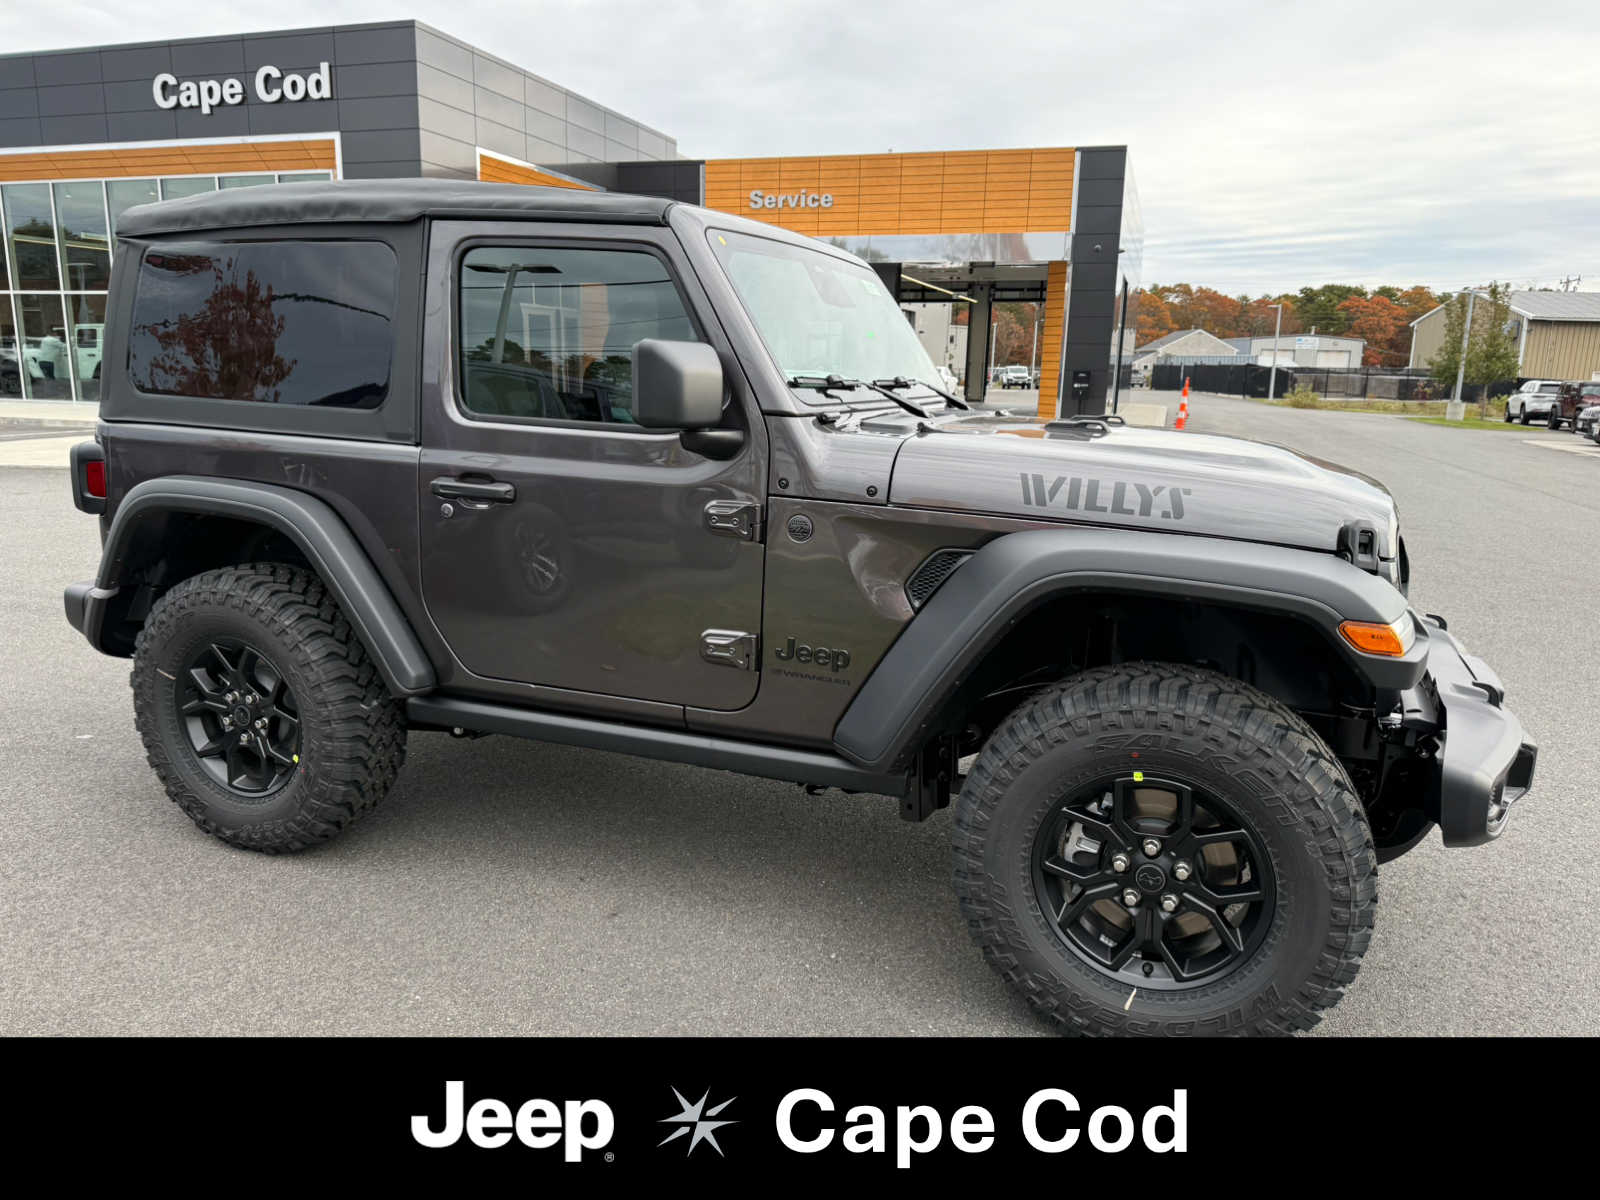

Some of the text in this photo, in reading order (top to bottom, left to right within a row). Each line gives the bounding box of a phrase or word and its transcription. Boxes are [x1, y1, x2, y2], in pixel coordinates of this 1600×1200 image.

[152, 61, 334, 115] Cape Cod
[749, 188, 835, 210] Service
[1019, 472, 1193, 521] WILLYS
[775, 636, 851, 673] Jeep
